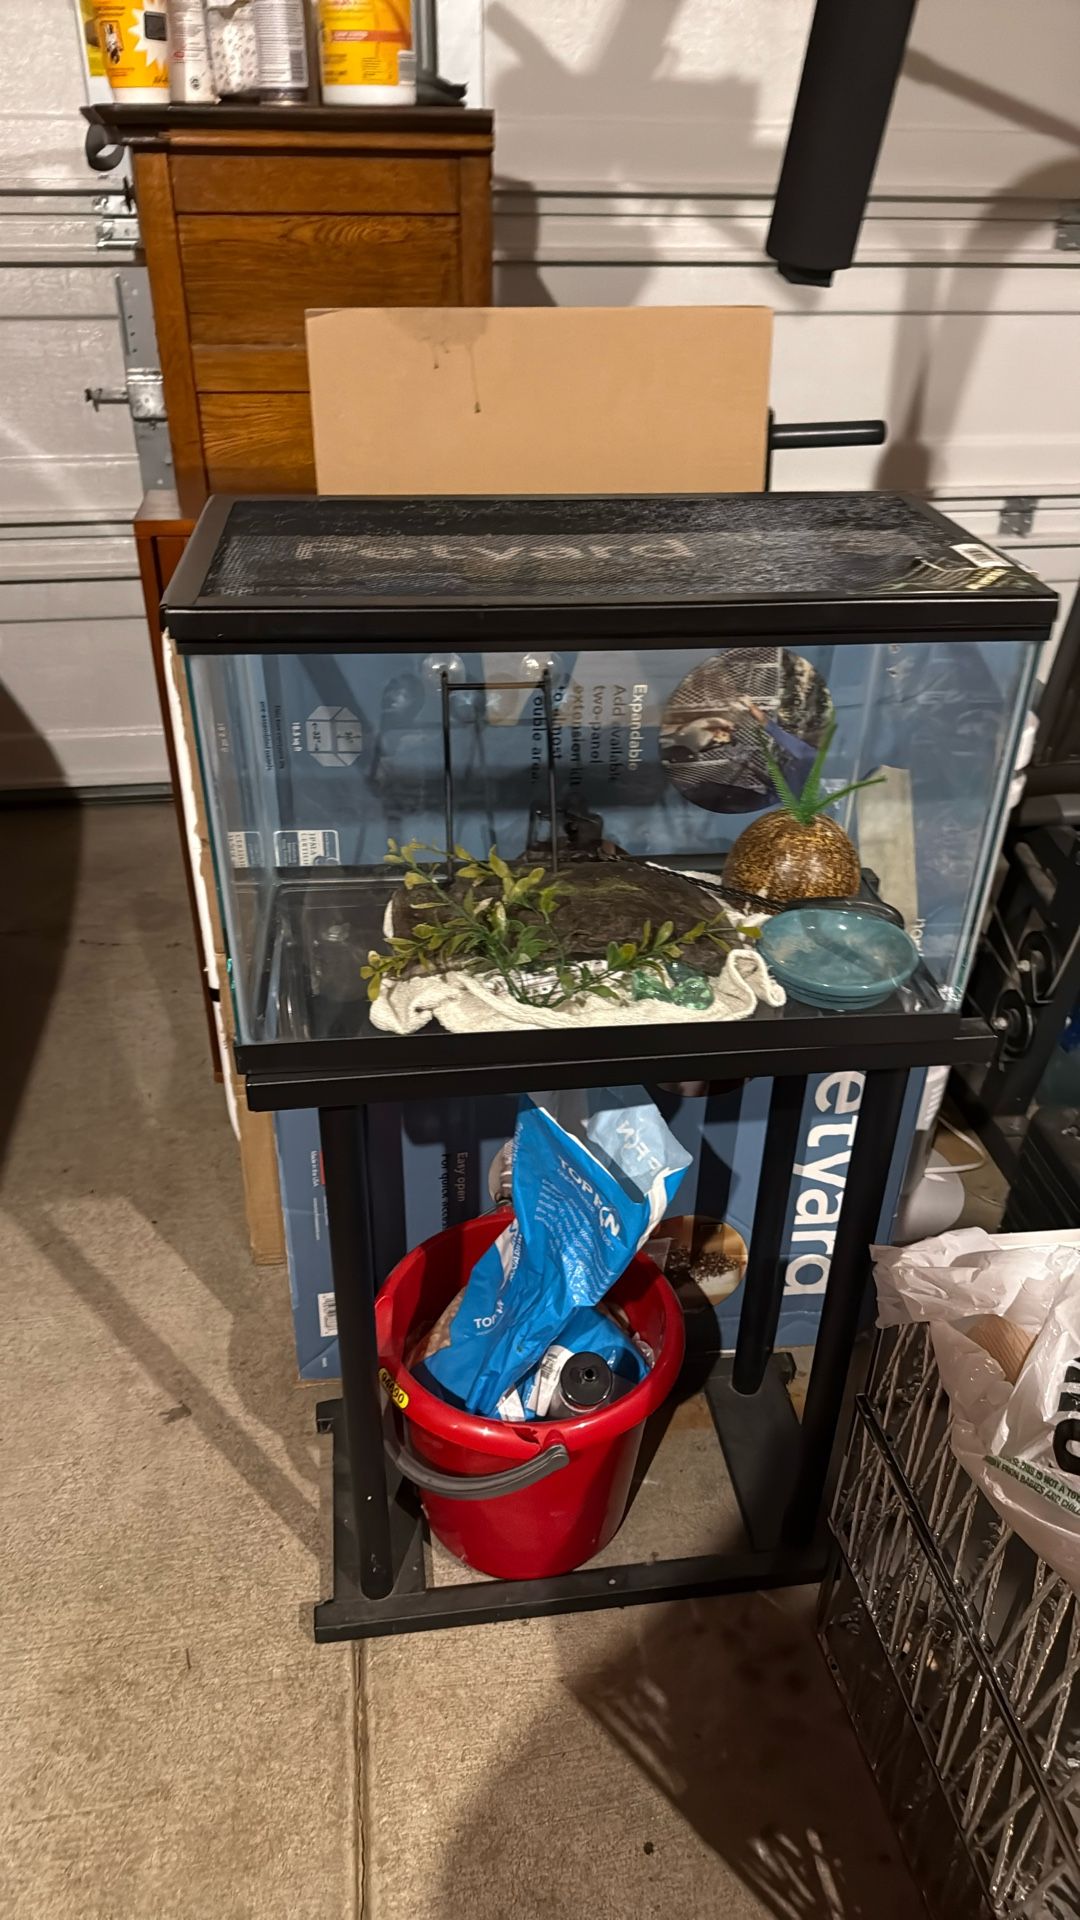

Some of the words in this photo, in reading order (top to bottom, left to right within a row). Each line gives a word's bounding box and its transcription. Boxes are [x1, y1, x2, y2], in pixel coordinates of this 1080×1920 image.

[589, 685, 606, 764] two-panel
[612, 685, 627, 716] Add
[628, 684, 648, 771] Expandable
[453, 1151, 469, 1175] Easy
[453, 1177, 467, 1202] open
[783, 1071, 867, 1296] etyard
